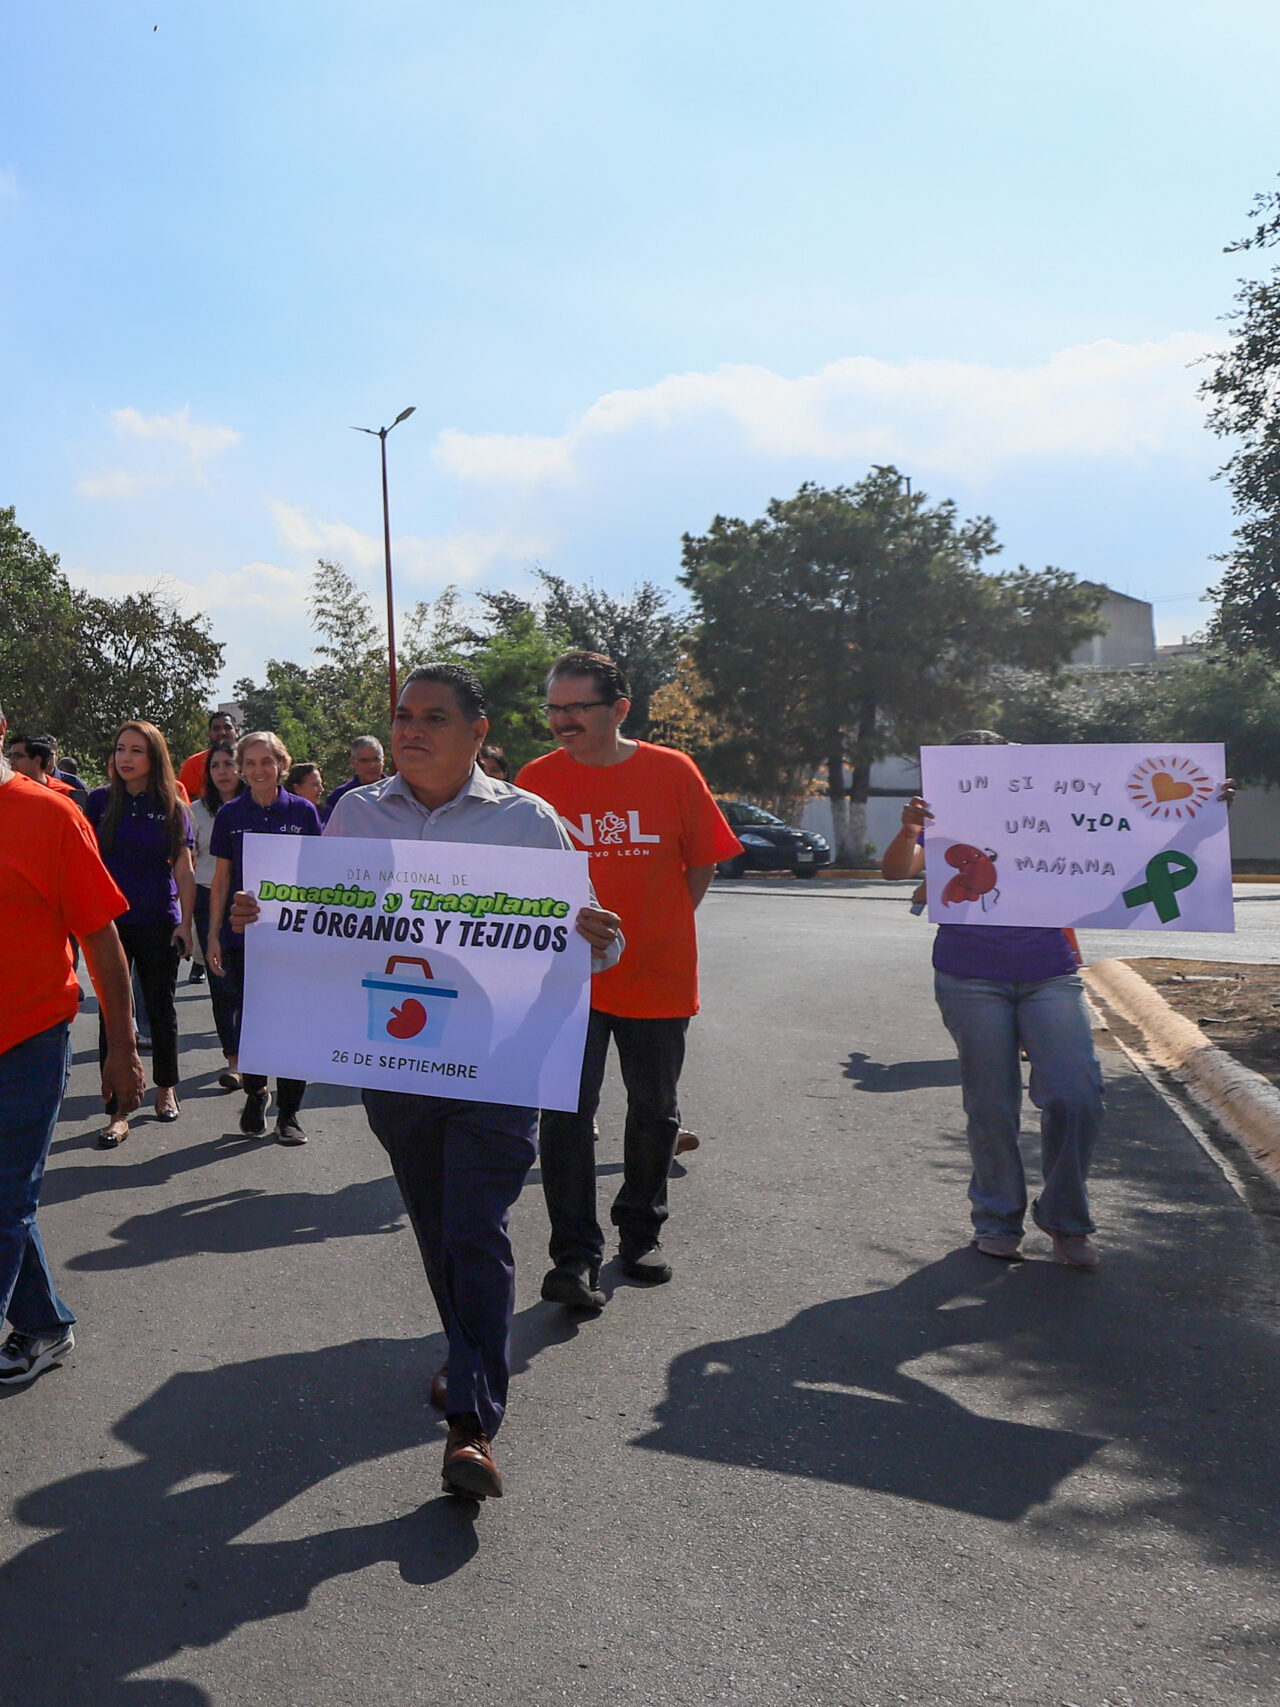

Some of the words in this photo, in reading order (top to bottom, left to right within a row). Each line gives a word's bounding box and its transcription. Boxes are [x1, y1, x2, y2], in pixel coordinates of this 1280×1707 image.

[958, 775, 989, 793] UN
[1008, 776, 1034, 792] SI
[1054, 778, 1102, 796] HOY
[1005, 815, 1050, 833] UNA
[1071, 813, 1131, 832] VIDA
[618, 848, 650, 856] LEÓN
[1015, 856, 1115, 876] MAÑANA
[347, 868, 370, 881] DIA
[379, 870, 441, 885] NACIONAL
[453, 874, 469, 887] DE
[258, 880, 376, 909] Donación
[382, 892, 403, 913] y
[410, 889, 571, 918] Trasplante
[277, 907, 307, 933] DE
[312, 906, 424, 944] ÓRGANOS
[434, 919, 451, 944] Y
[459, 920, 568, 953] TEJIDOS
[331, 1050, 349, 1064] 26
[353, 1052, 373, 1066] DE
[379, 1055, 478, 1079] SEPTIEMBRE
